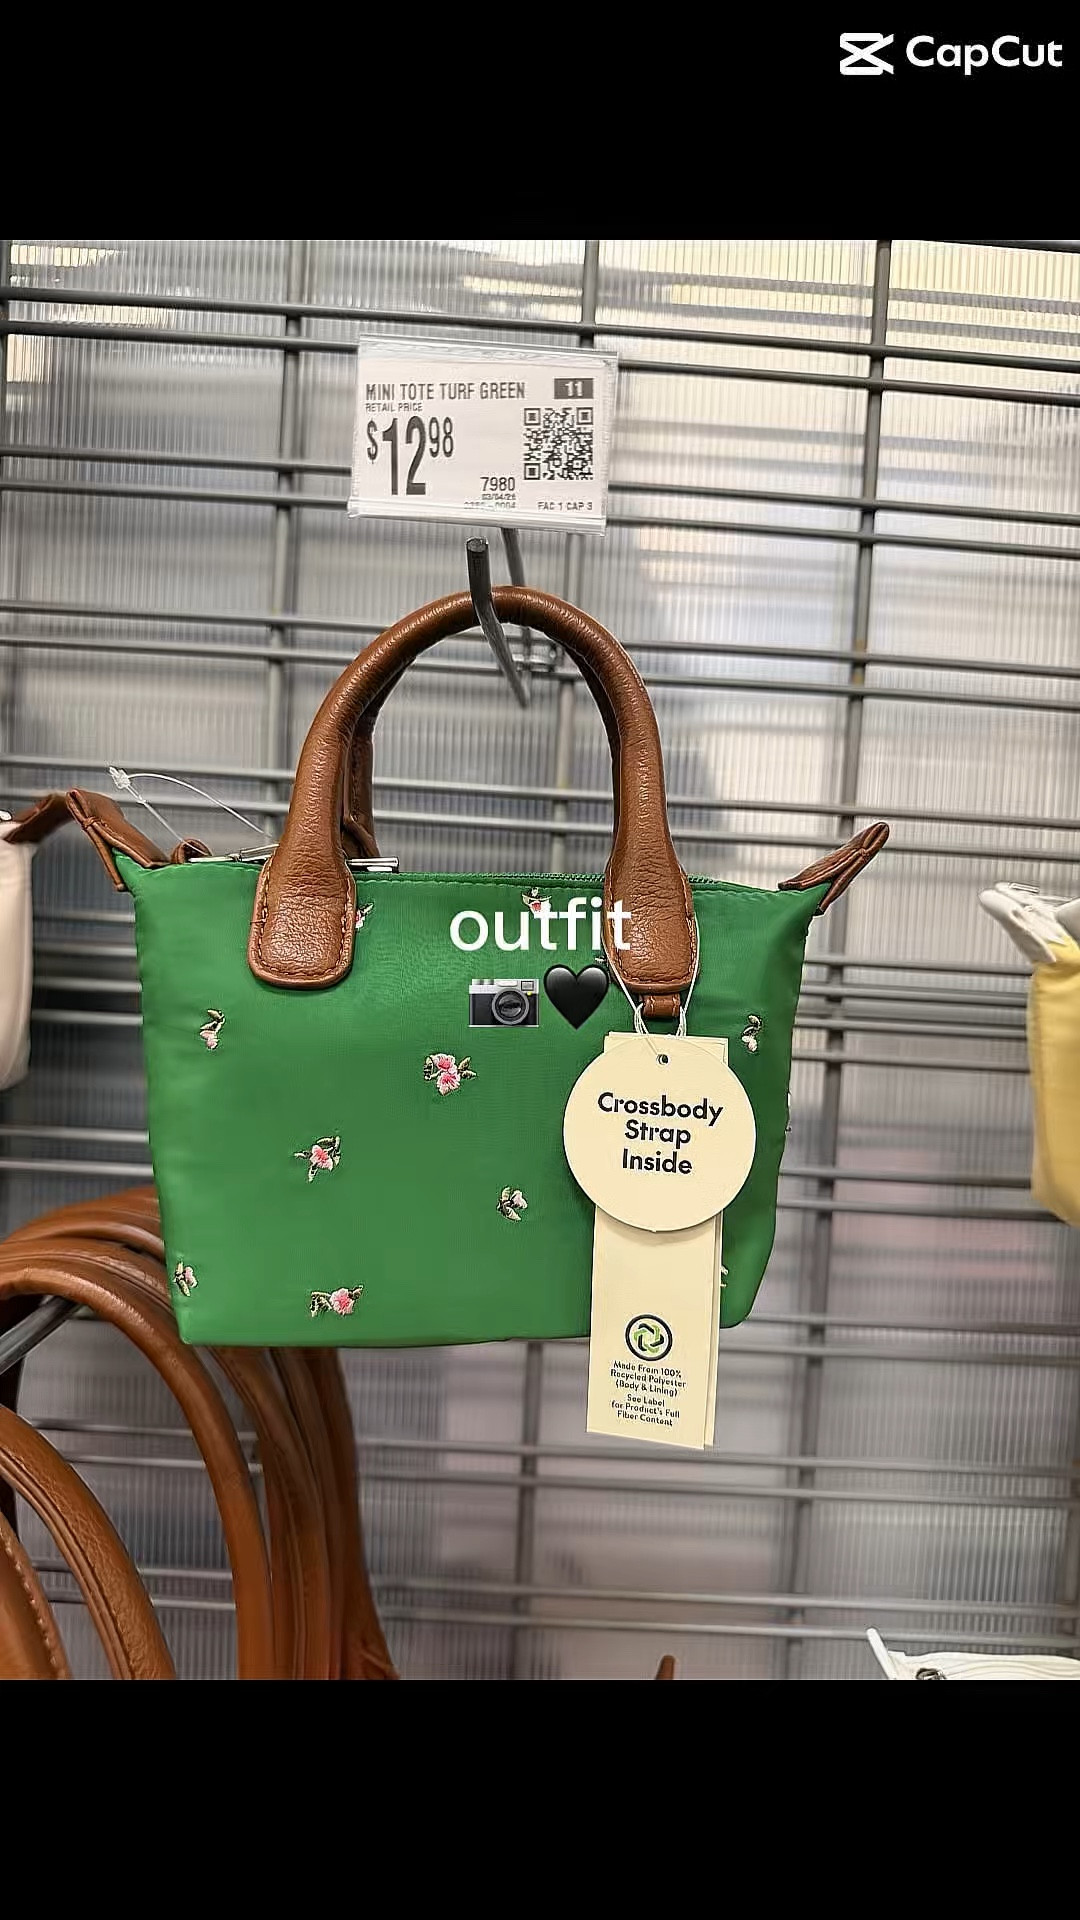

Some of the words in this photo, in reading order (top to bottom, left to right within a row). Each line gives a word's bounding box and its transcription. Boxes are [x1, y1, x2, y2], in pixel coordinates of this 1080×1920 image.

[366, 383, 395, 401] MINI
[399, 383, 434, 400] TOTE
[439, 382, 475, 400] TURF
[480, 381, 526, 399] GREEN
[565, 381, 584, 397] 11
[365, 402, 396, 412] RETAIL
[398, 402, 423, 411] PRICE
[480, 476, 516, 491] 7980
[537, 502, 555, 510] FAC
[566, 502, 585, 510] CAP
[598, 1092, 723, 1126] Crossbody
[625, 1119, 691, 1149] Strap
[622, 1148, 692, 1174] Inside
[613, 1360, 636, 1371] Made
[638, 1364, 659, 1375] From
[661, 1368, 682, 1378] 100%
[610, 1369, 647, 1382] Recycled
[648, 1375, 687, 1388] Polyester
[615, 1379, 639, 1392] (Body
[649, 1384, 678, 1397] Lining)
[611, 1400, 624, 1408] for
[625, 1402, 663, 1415] Product's
[665, 1409, 680, 1418] Full
[627, 1393, 641, 1403] See
[643, 1397, 665, 1407] Label
[617, 1409, 638, 1420] Fiber
[639, 1413, 673, 1427] Content
